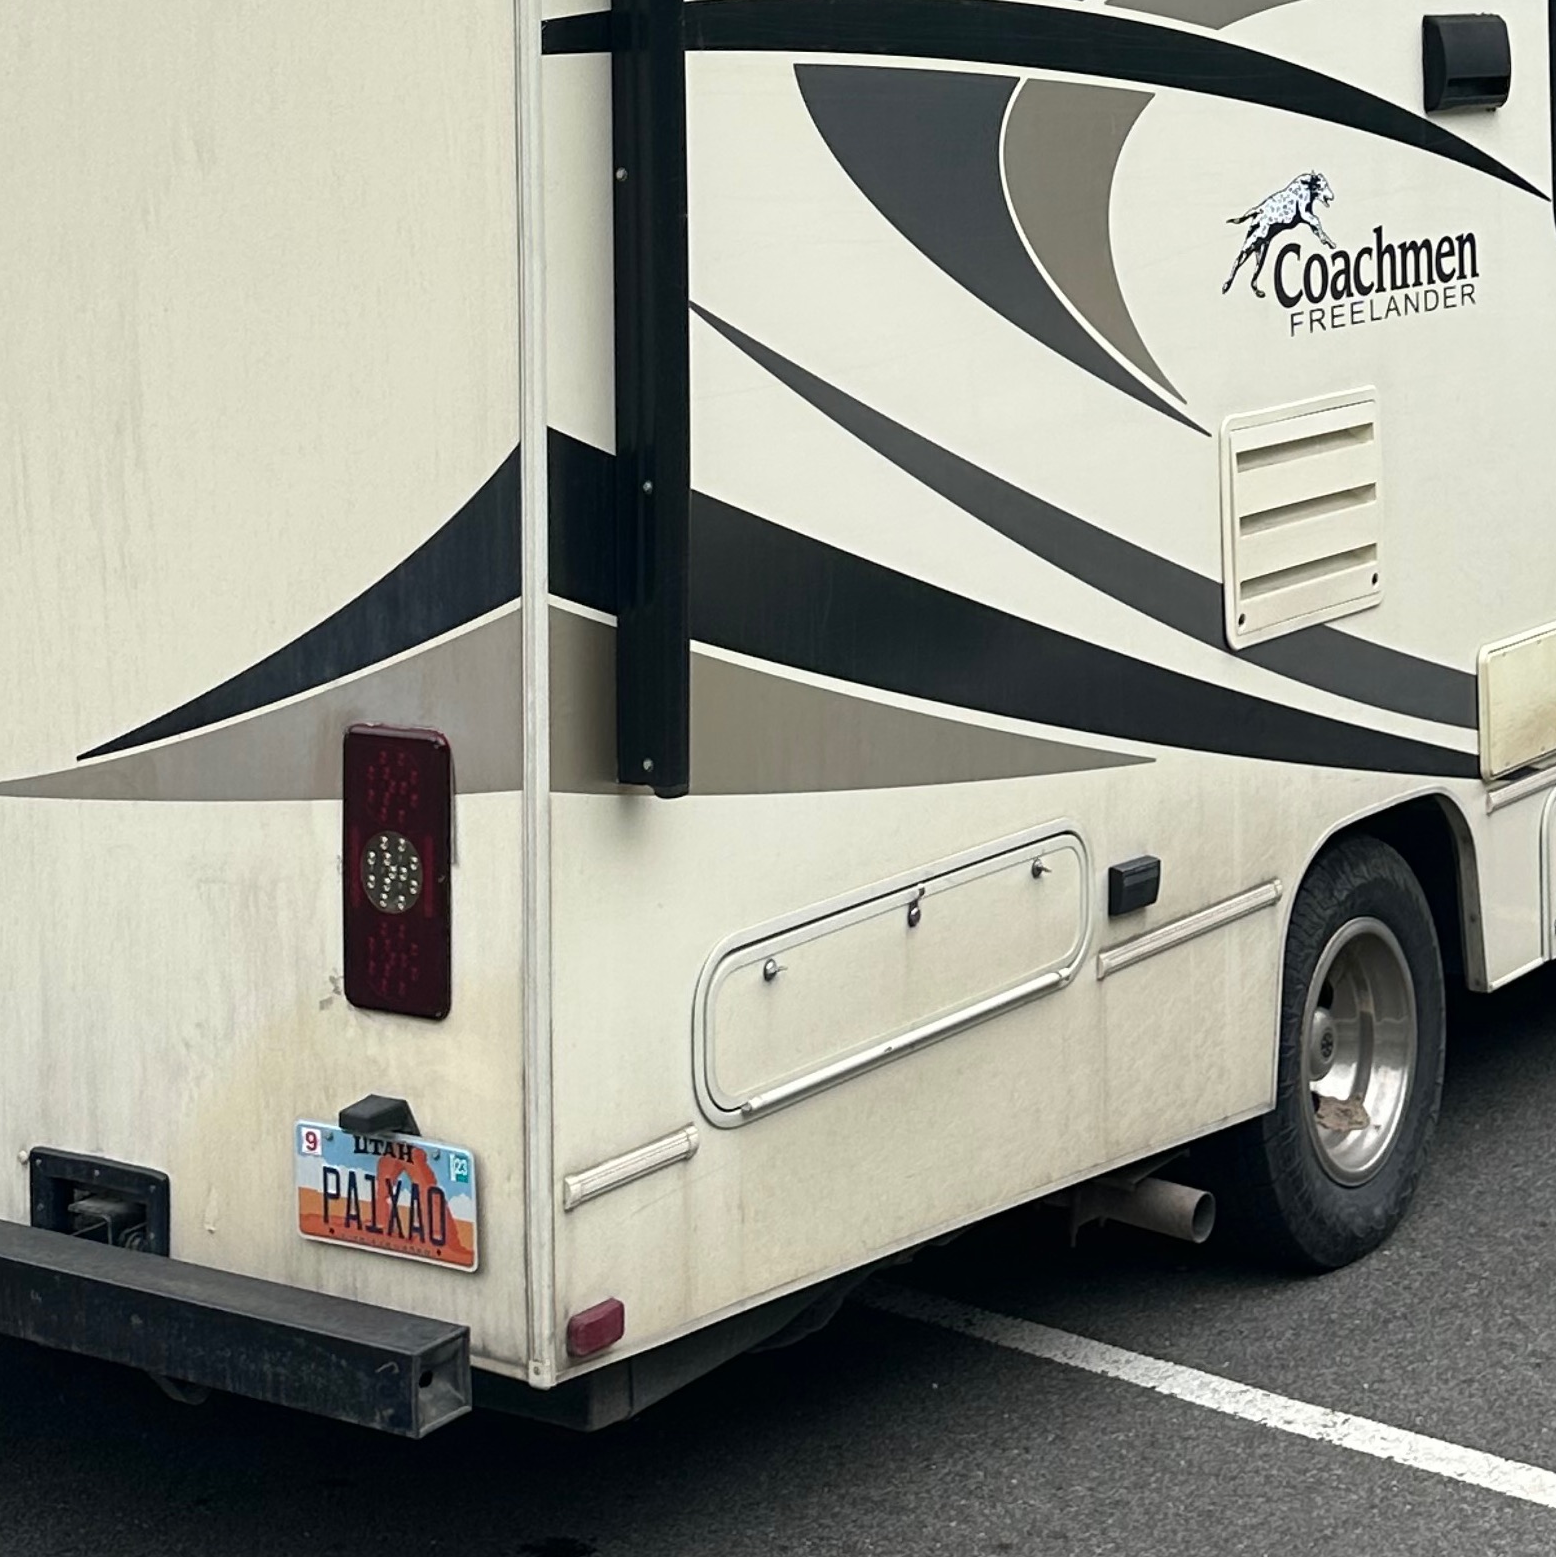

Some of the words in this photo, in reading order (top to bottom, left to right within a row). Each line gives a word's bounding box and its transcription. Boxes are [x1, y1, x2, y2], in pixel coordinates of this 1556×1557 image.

[1274, 226, 1480, 309] Coachmen
[1290, 283, 1477, 337] FREELANDER
[305, 1131, 319, 1152] 9
[353, 1134, 414, 1164] UTAH
[322, 1165, 447, 1247] PAIXAO
